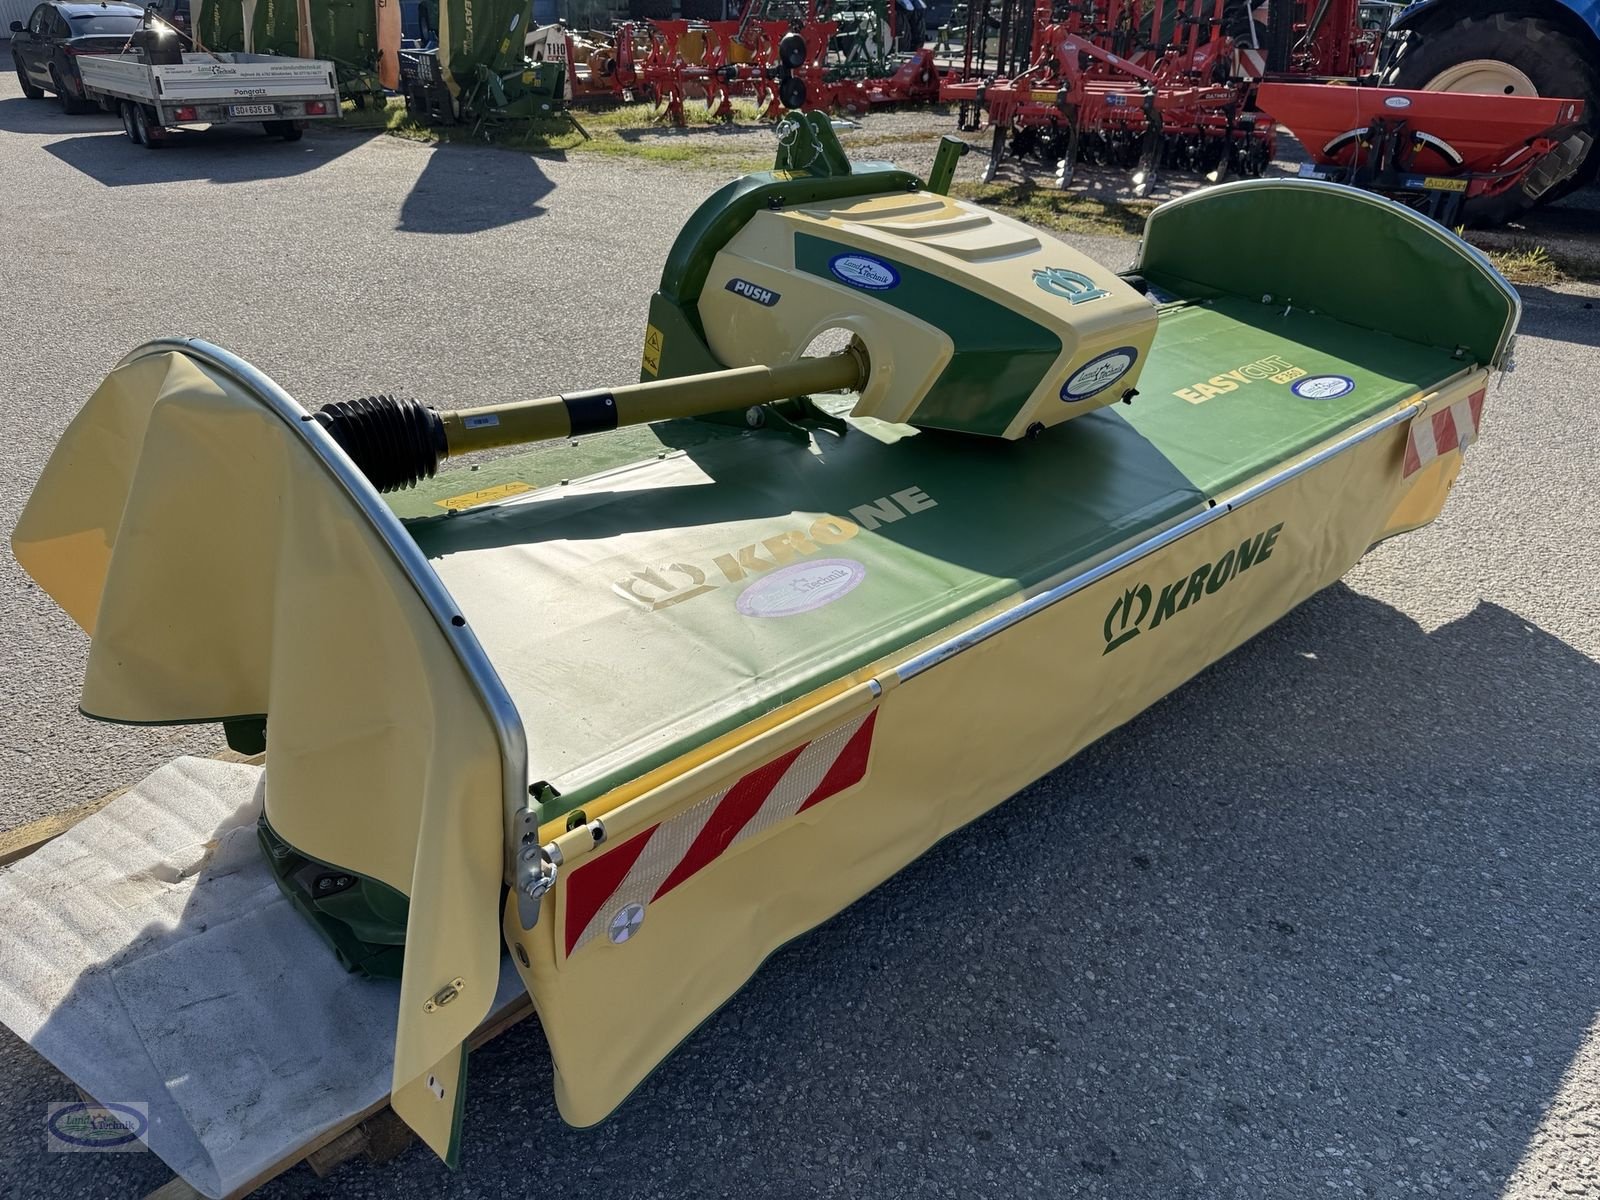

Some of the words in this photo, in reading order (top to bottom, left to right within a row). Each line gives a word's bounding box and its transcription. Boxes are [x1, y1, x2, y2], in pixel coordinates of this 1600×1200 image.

[234, 88, 266, 96] Pongratz
[249, 105, 263, 114] 635
[843, 259, 862, 270] Land
[862, 269, 889, 285] Technik
[734, 280, 772, 304] PUSH
[1172, 354, 1293, 404] EASYCUT
[711, 485, 939, 584] KRONE
[804, 568, 848, 594] Technik
[1148, 522, 1285, 630] KRONE
